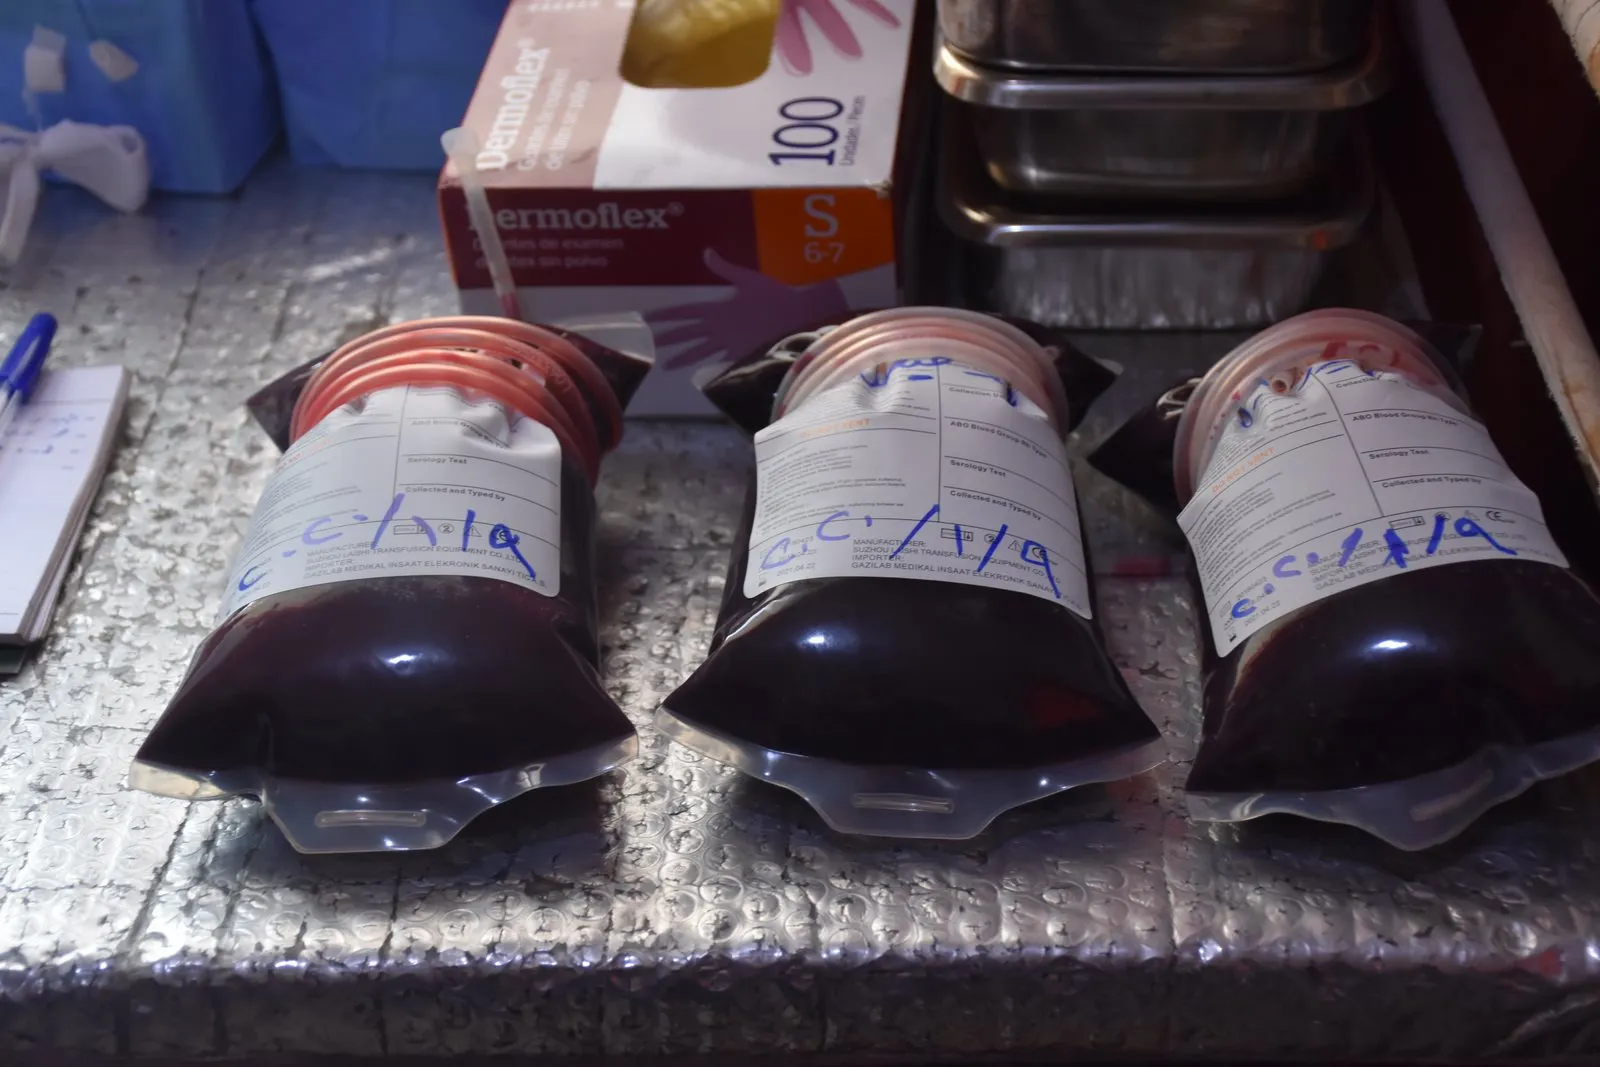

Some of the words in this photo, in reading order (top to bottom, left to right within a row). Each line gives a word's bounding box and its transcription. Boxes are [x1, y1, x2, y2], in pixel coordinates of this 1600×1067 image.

[768, 96, 844, 166] 100
[804, 194, 839, 238] S
[449, 457, 467, 465] Test
[1369, 451, 1408, 460] Serology
[950, 459, 987, 473] Serology
[989, 466, 1006, 478] Test
[1382, 477, 1425, 488] Collected
[1426, 475, 1443, 484] and
[1444, 475, 1470, 484] Typed
[405, 486, 448, 494] Collected
[449, 487, 466, 495] and
[467, 488, 495, 500] Typed
[950, 489, 991, 503] Collected
[992, 498, 1007, 508] and
[1009, 502, 1032, 517] Typed
[853, 546, 889, 554] SUZHOU
[345, 562, 386, 574] MEDIKAL
[388, 561, 421, 569] INSAAT
[424, 560, 480, 569] ELEKRONIK
[851, 561, 892, 569] GAZILAB
[893, 562, 934, 573] MEDIKAL
[937, 563, 970, 576] INSAAT
